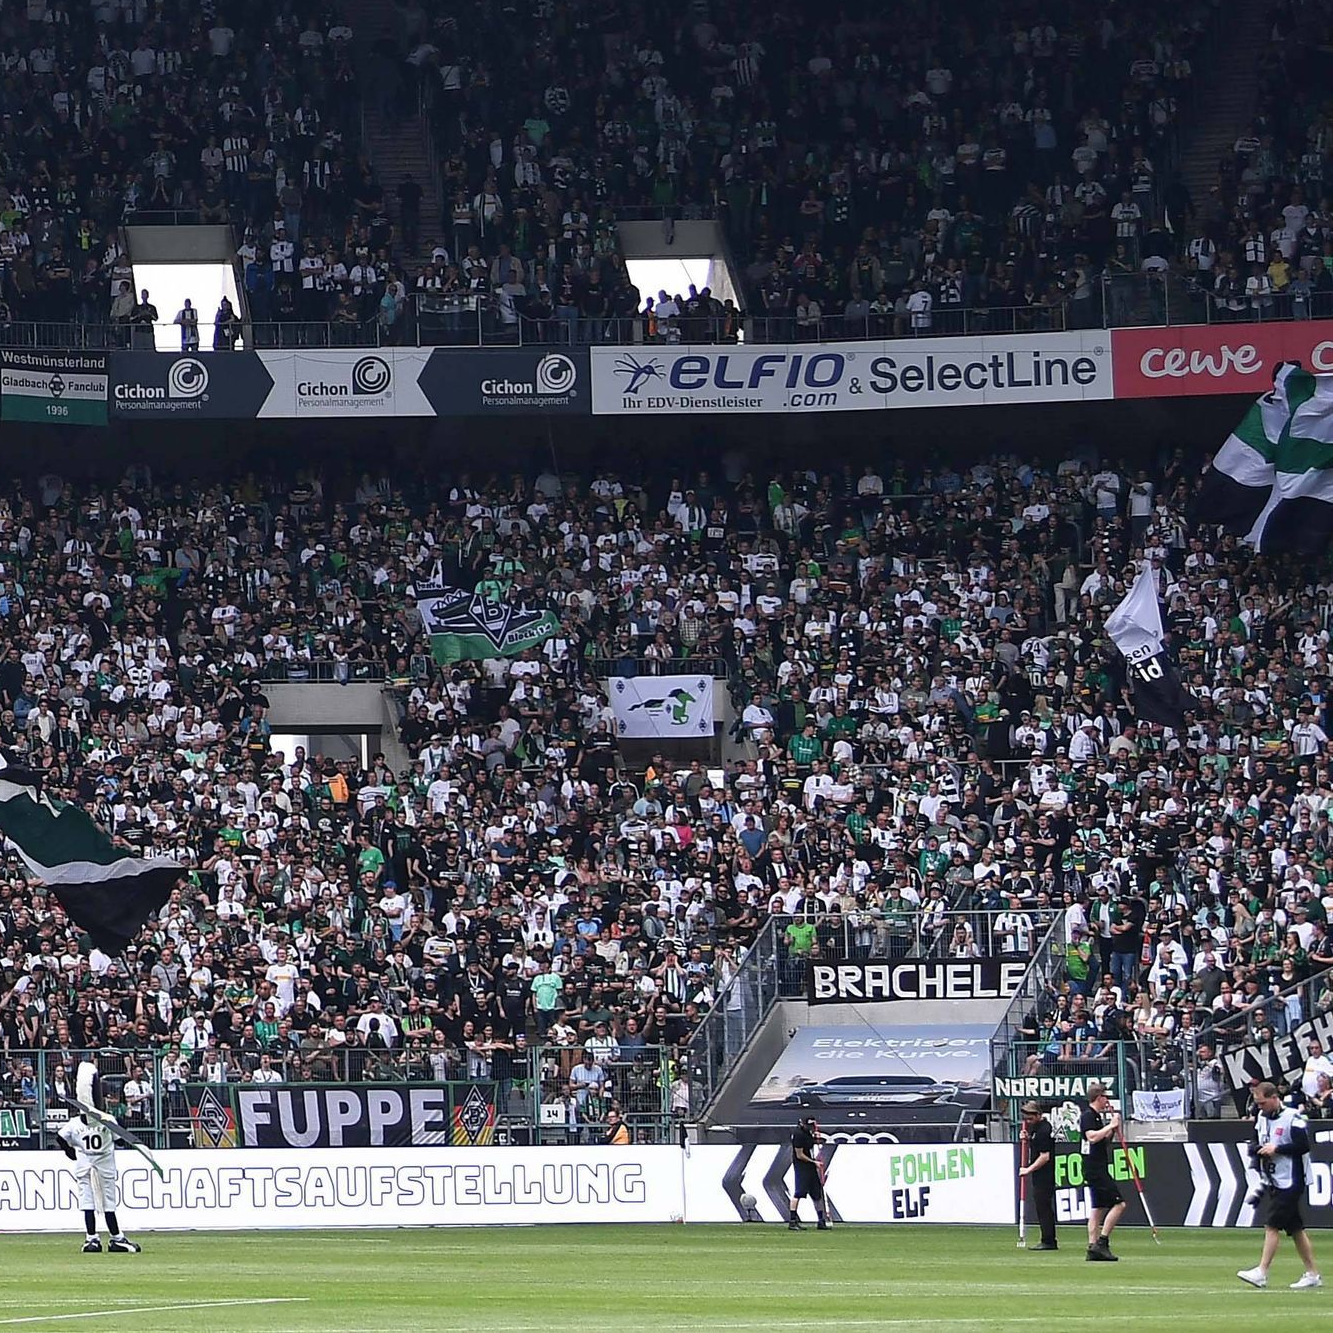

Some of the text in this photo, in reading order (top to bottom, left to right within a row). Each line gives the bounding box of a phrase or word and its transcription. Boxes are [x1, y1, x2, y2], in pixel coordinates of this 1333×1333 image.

[1, 350, 106, 370] Westmünsterland
[1140, 343, 1263, 378] cewe
[869, 351, 1097, 394] SelectLine
[67, 380, 105, 393] Fanclub
[112, 382, 163, 400] Cichon
[297, 381, 347, 398] Cichon
[480, 378, 532, 397] Cichon
[623, 386, 837, 409] Ihr EDV-Dienstleister .com
[44, 404, 69, 417] 1996
[507, 631, 535, 645] Block
[813, 1049, 978, 1060] die Kurve.
[1224, 1011, 1333, 1091] KYFFH
[238, 1088, 446, 1147] FUPPE
[546, 1110, 559, 1121] 14
[82, 1134, 103, 1150] 10
[890, 1147, 976, 1187] FOHLEN
[1055, 1147, 1146, 1188] FOEN
[892, 1188, 931, 1218] ELF
